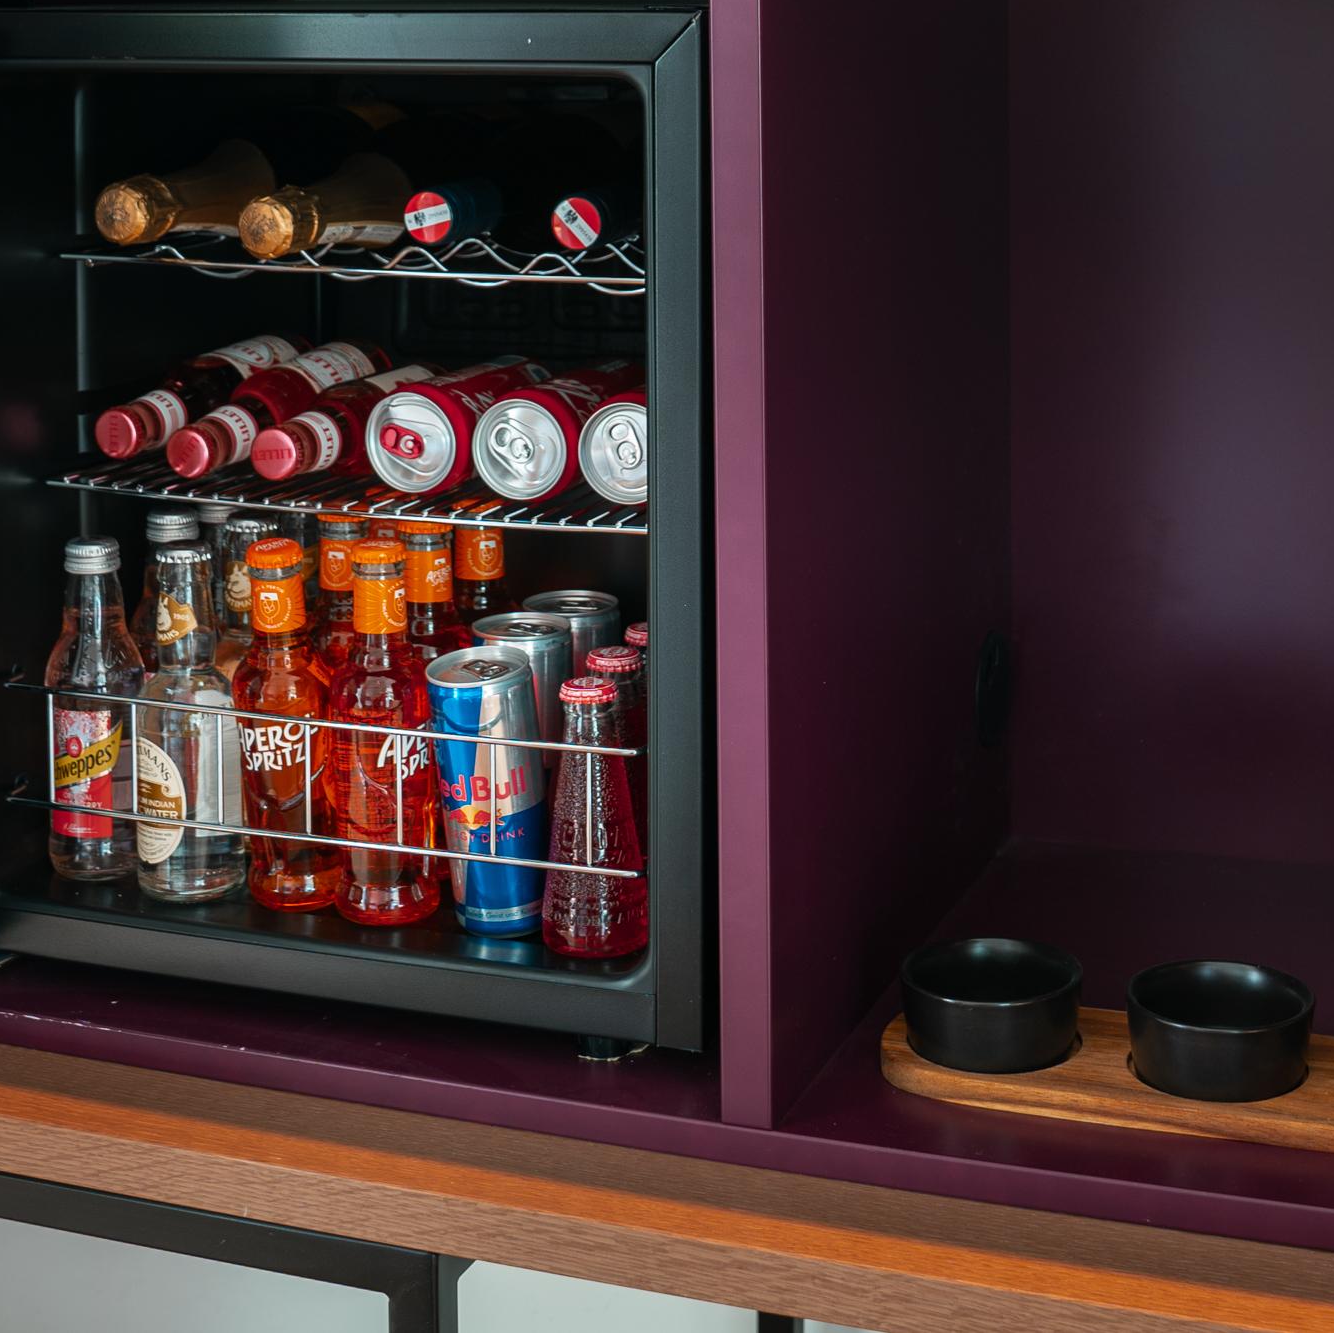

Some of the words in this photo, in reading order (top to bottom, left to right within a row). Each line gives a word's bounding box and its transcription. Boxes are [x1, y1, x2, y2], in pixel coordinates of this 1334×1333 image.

[439, 774, 467, 802] ed
[470, 765, 526, 802] Bull
[148, 798, 175, 809] INDIAN
